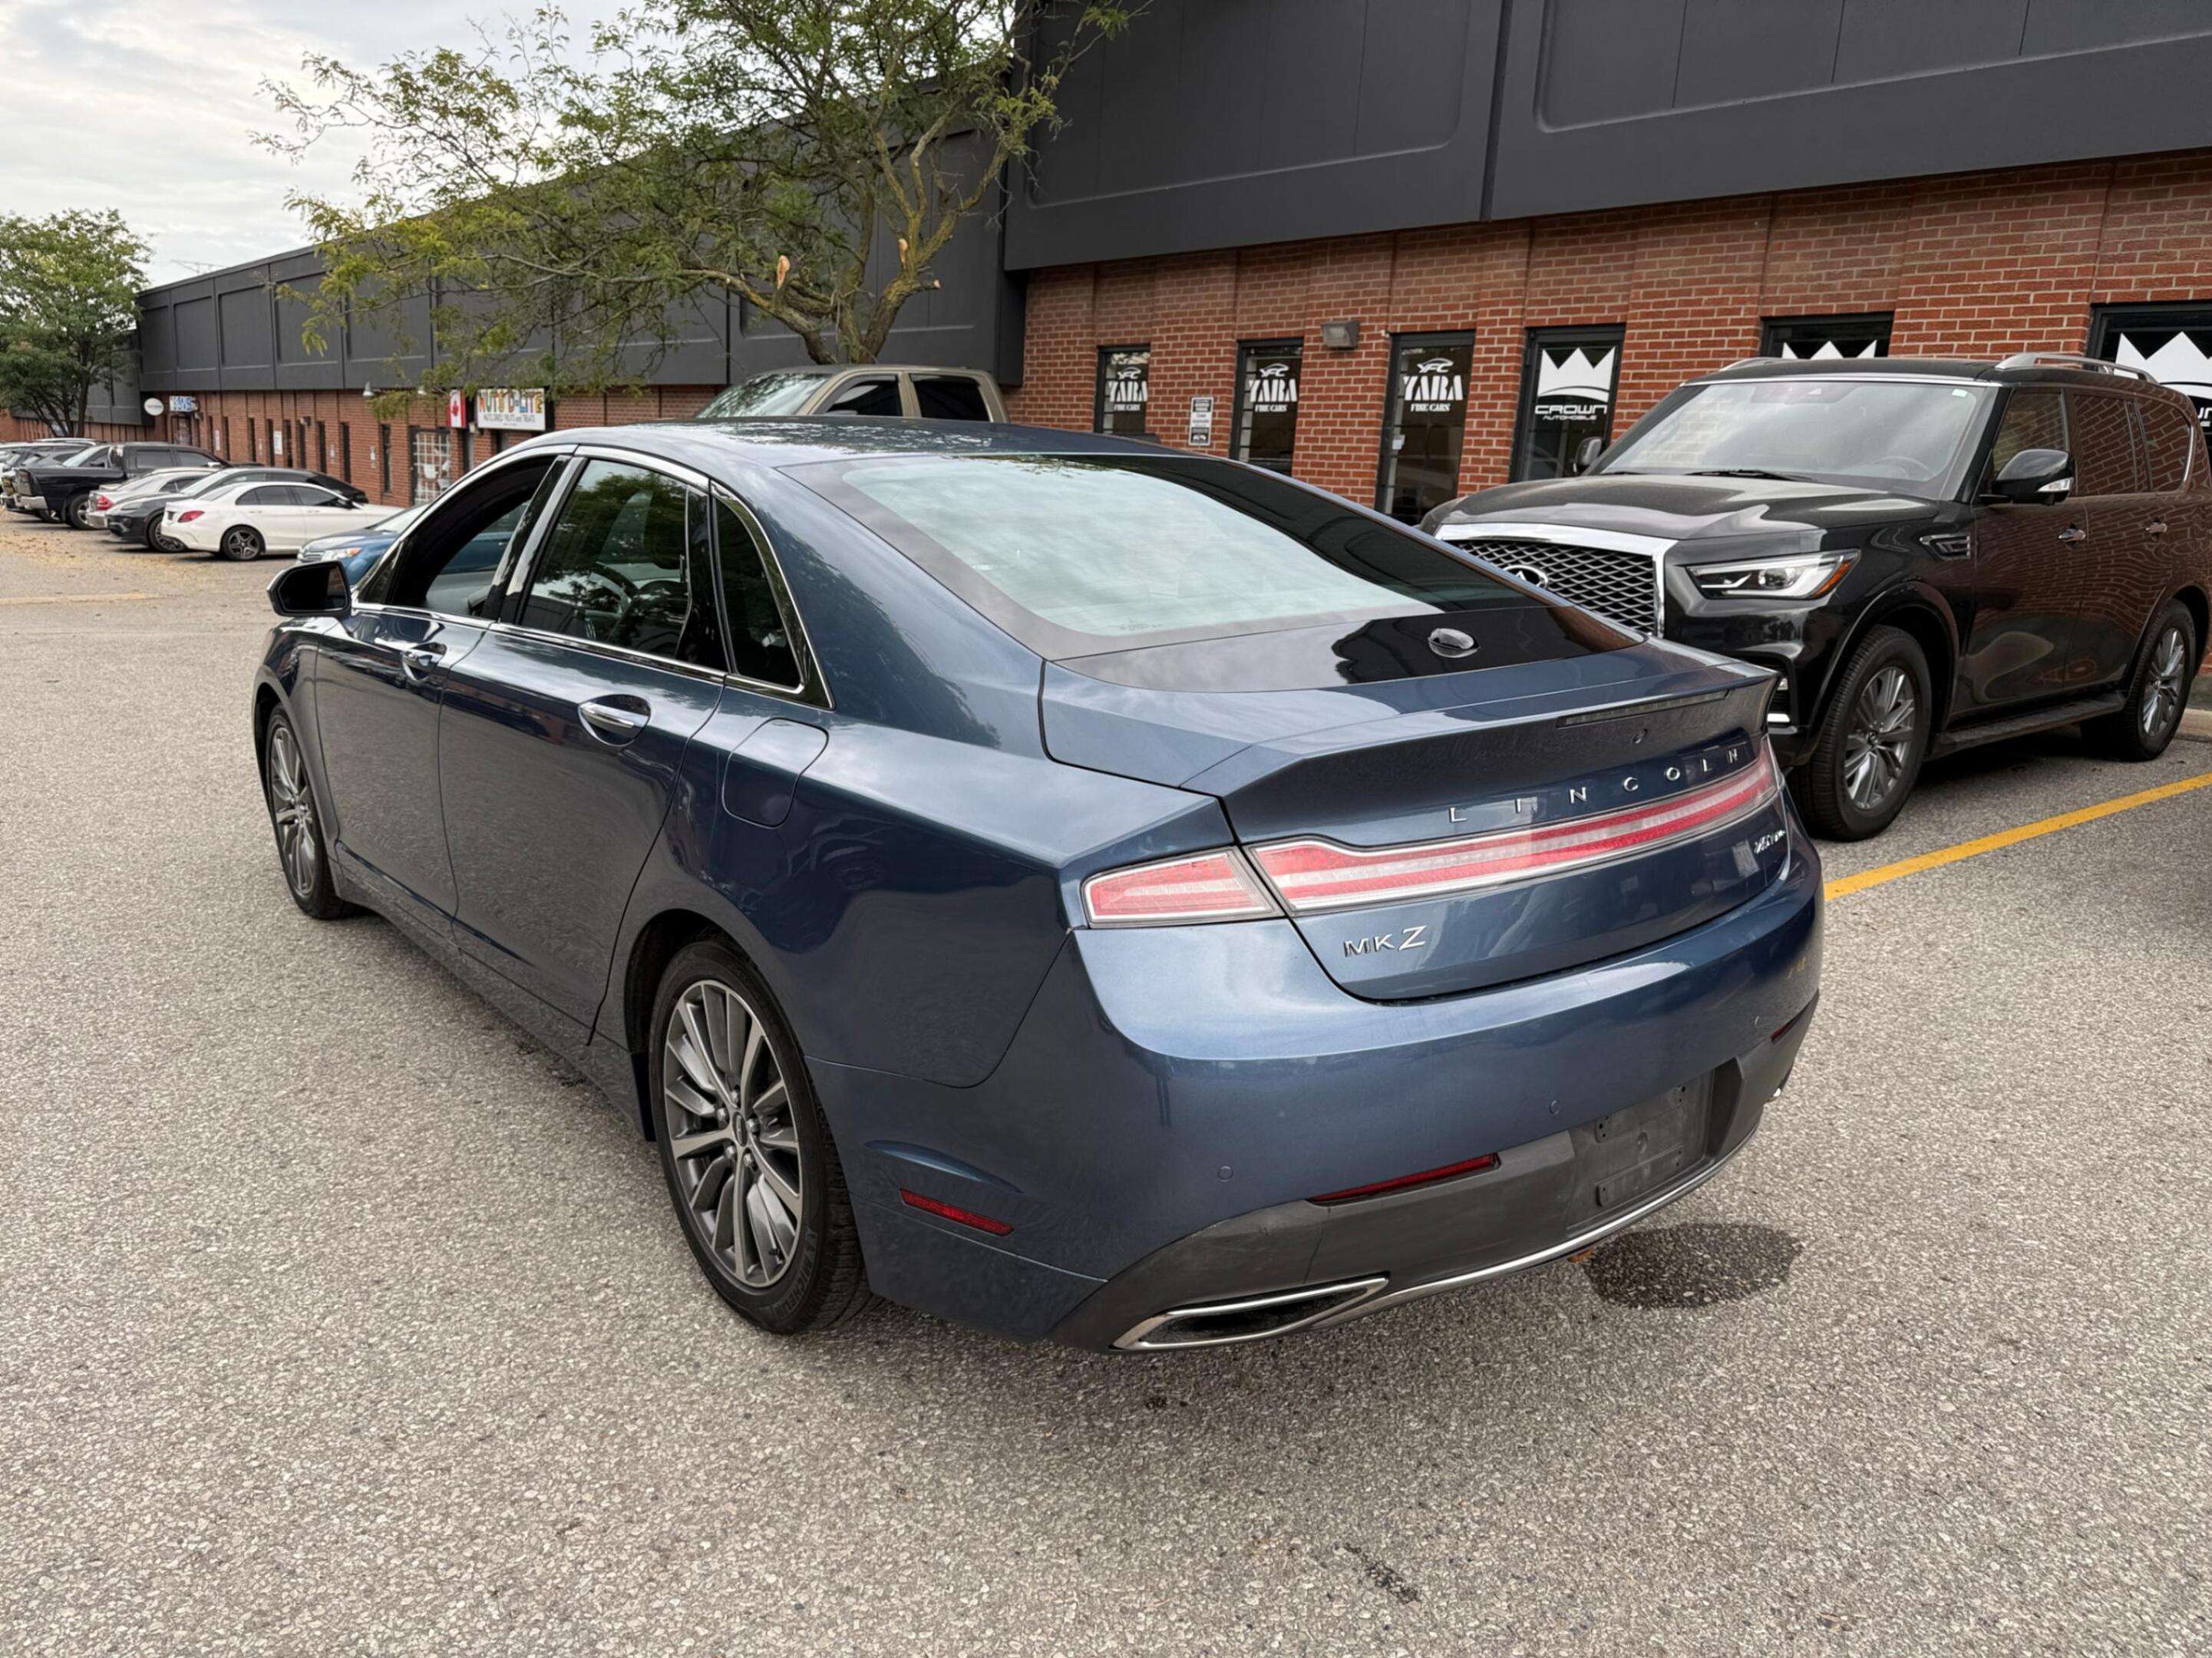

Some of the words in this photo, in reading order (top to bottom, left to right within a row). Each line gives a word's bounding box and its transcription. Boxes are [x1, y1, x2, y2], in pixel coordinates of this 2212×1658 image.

[1108, 381, 1148, 402] YARA
[1249, 379, 1298, 402] YARA
[1403, 375, 1463, 401] YARA
[1428, 402, 1451, 411] CARS
[1534, 405, 1608, 414] CROWN
[1448, 748, 1738, 823] LINCOLN
[1342, 925, 1428, 958] MKZ
